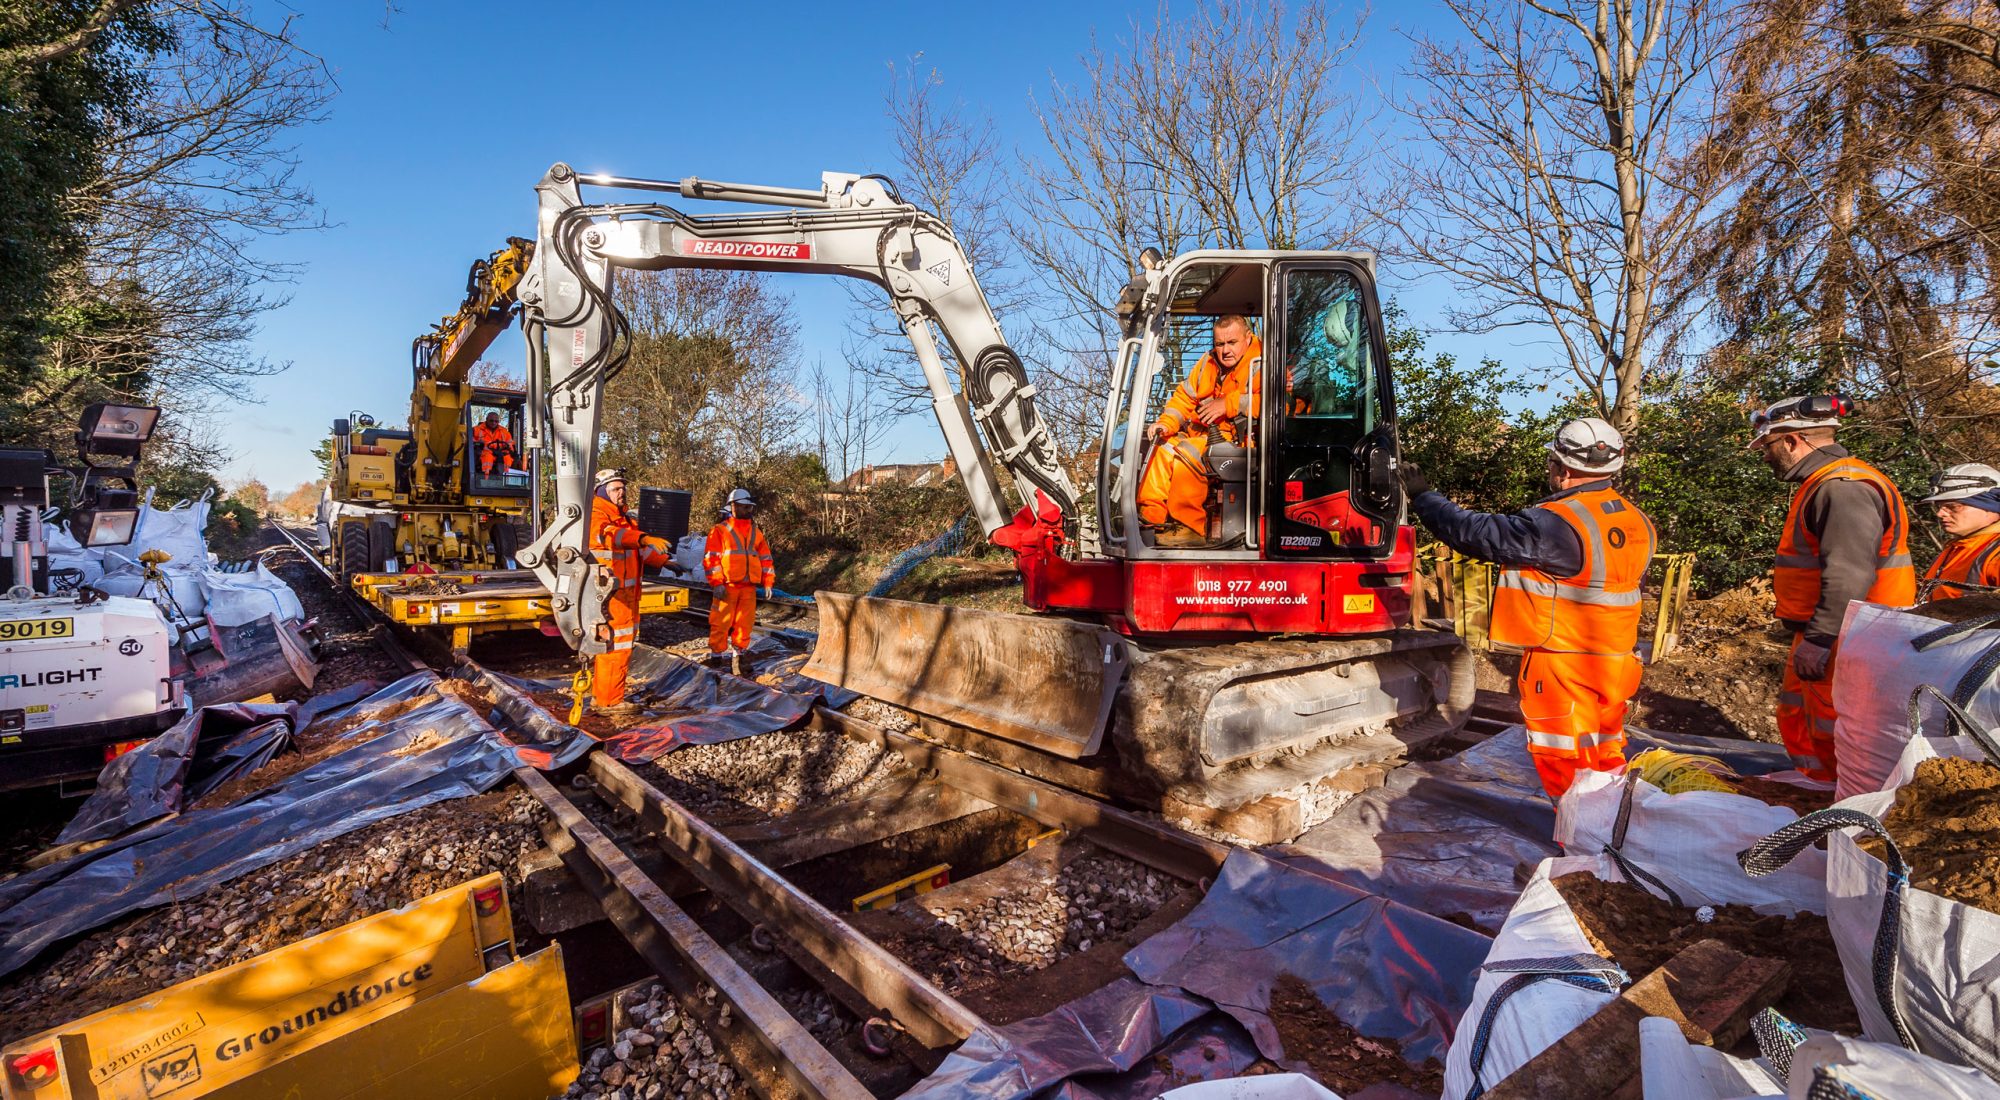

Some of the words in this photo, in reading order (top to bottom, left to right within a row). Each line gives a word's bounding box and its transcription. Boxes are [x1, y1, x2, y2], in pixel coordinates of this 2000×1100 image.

[693, 241, 799, 257] READYPOWER
[1197, 581, 1221, 591] 0118
[1227, 581, 1252, 591] 977
[1258, 581, 1287, 591] 4901
[1176, 593, 1308, 607] www.readypower.co.uk
[0, 620, 67, 639] 9019
[121, 642, 142, 653] 50
[216, 962, 433, 1061] Groundforce
